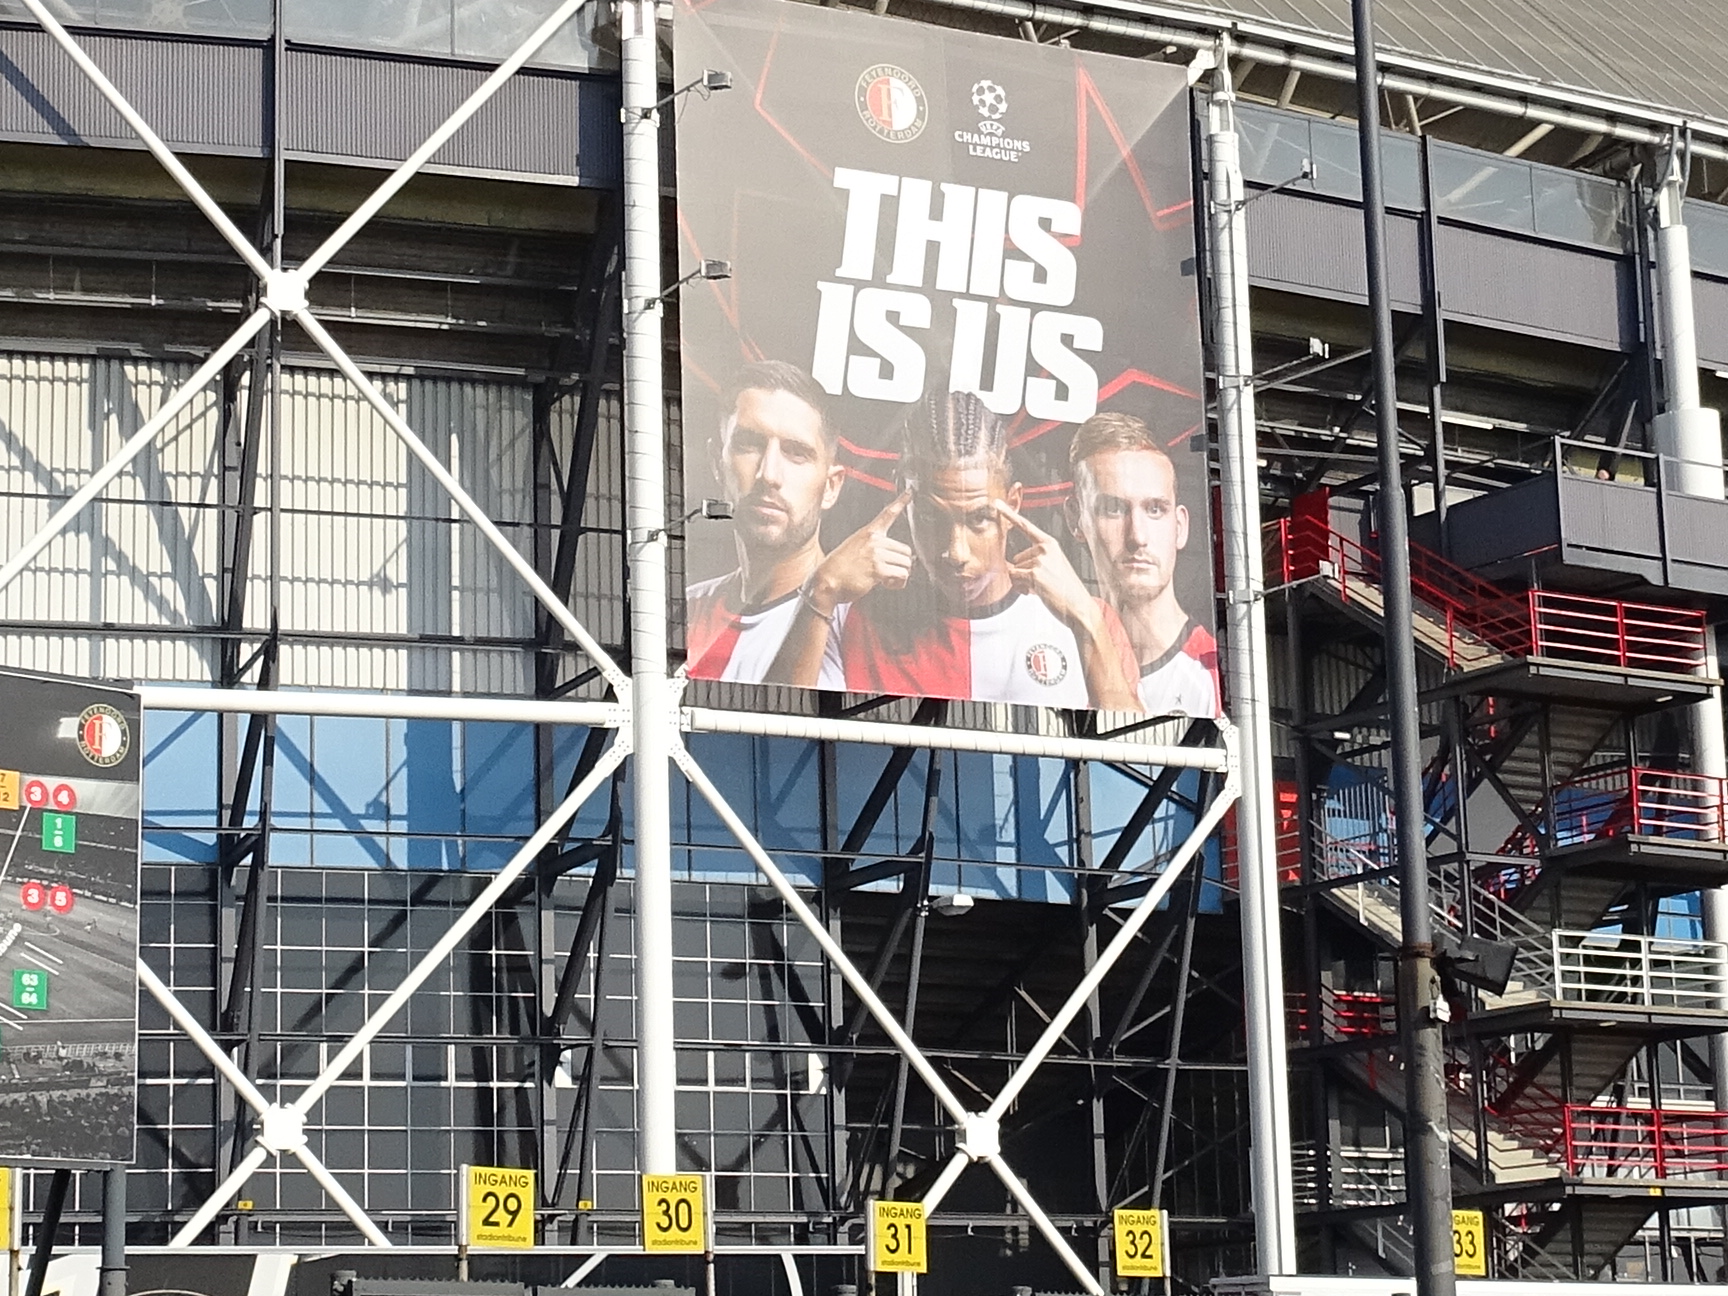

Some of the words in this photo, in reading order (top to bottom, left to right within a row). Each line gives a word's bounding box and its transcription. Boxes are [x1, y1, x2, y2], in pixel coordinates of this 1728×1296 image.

[861, 67, 922, 98] FEYENOORD
[861, 109, 923, 140] ROTTERDAM
[978, 121, 1005, 136] UEFA
[954, 131, 1030, 152] CHAMPIONS
[969, 145, 1020, 162] LEAGUE
[832, 168, 1081, 306] THIS
[812, 282, 931, 402] IS
[949, 298, 1103, 423] US
[0, 773, 7, 783] 7
[29, 786, 42, 801] 3
[57, 790, 70, 804] 4
[54, 817, 63, 829] 1
[27, 888, 40, 903] 3
[54, 891, 67, 906] 5
[474, 1172, 529, 1189] INGANG
[647, 1180, 698, 1194] INGANG
[481, 1191, 522, 1228] 29
[655, 1197, 693, 1233] 30
[879, 1206, 922, 1219] INGANG
[1118, 1214, 1157, 1227] INGANG
[1453, 1215, 1480, 1227] GANG
[476, 1233, 527, 1243] stadiontribune
[651, 1237, 698, 1247] stadiontribune
[884, 1223, 913, 1255] 31
[1124, 1230, 1153, 1260] 32
[1453, 1230, 1477, 1258] 33
